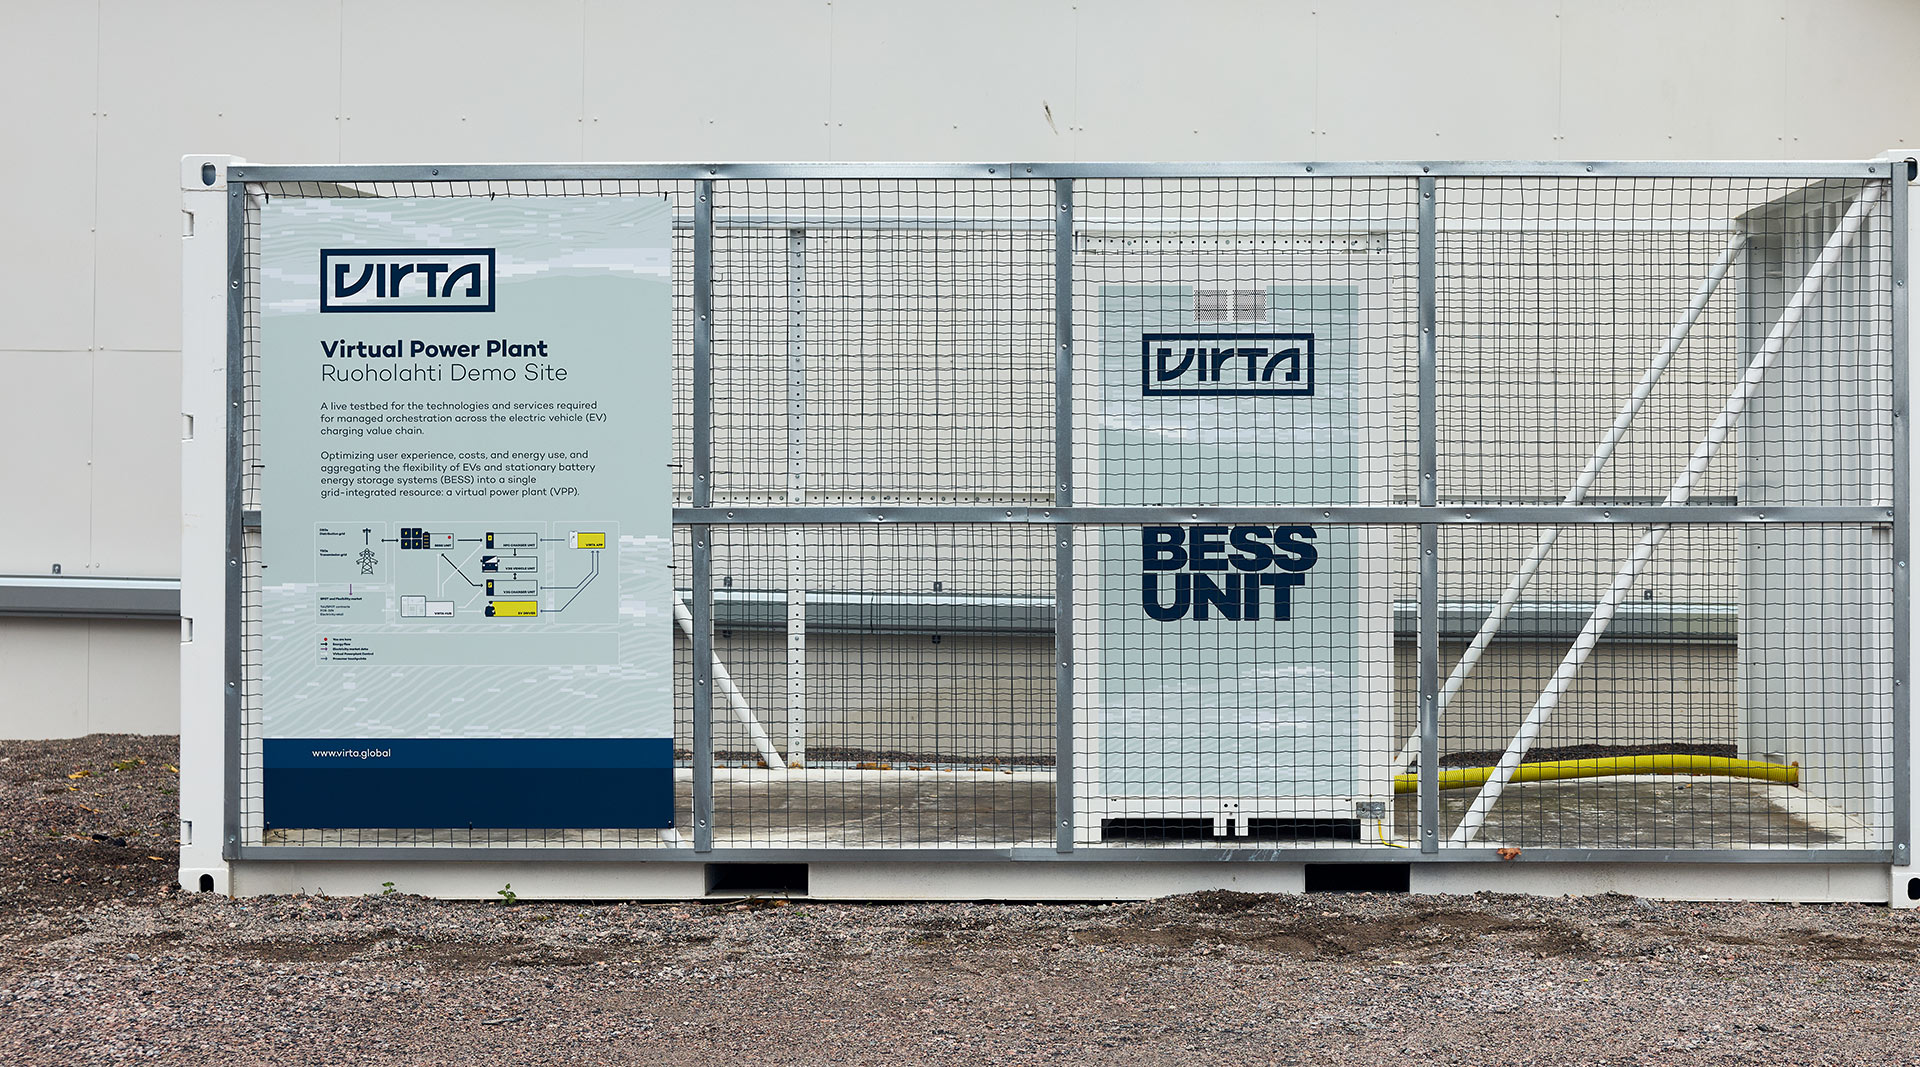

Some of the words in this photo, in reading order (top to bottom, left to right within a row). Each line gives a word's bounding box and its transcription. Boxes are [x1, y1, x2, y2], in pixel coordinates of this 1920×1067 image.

[335, 263, 481, 298] VIRTA
[320, 339, 402, 358] Virtual
[411, 340, 480, 358] Power
[487, 339, 548, 357] Plant
[1158, 348, 1300, 382] VIRTA
[322, 363, 441, 382] Ruoholahti
[451, 364, 516, 381] Demo
[525, 363, 567, 381] Site
[320, 402, 328, 410] A
[331, 402, 347, 411] live
[350, 401, 388, 411] testbed
[391, 401, 405, 410] for
[407, 401, 424, 410] the
[426, 401, 489, 413] technologies
[492, 401, 510, 410] and
[514, 401, 554, 411] services
[557, 401, 597, 411] required
[320, 414, 334, 423] for
[337, 414, 383, 425] managed
[386, 414, 452, 423] orchestration
[490, 414, 506, 422] the
[509, 413, 546, 422] electric
[549, 413, 583, 422] vehicle
[586, 413, 607, 422] (EV)
[320, 426, 363, 437] charging
[366, 428, 392, 436] value
[395, 426, 424, 435] chain.
[321, 451, 374, 462] Optimizing
[401, 450, 456, 461] experience,
[459, 451, 488, 460] costs,
[490, 450, 509, 459] and
[512, 452, 545, 462] energy
[548, 452, 567, 460] use,
[570, 450, 588, 459] and
[321, 463, 381, 474] aggregating
[383, 463, 400, 472] the
[402, 463, 447, 473] flexibility
[450, 463, 460, 471] of
[463, 463, 481, 471] EVs
[484, 463, 502, 471] and
[505, 463, 556, 473] stationary
[559, 463, 595, 473] battery
[321, 478, 354, 487] energy
[357, 476, 394, 486] storage
[397, 476, 438, 486] systems
[440, 475, 474, 485] (BESS)
[477, 475, 496, 484] into
[508, 475, 536, 486] single
[321, 488, 396, 499] grid-integrated
[455, 488, 486, 496] virtual
[490, 490, 519, 498] power
[522, 488, 547, 498] plant
[550, 487, 579, 496] (VPP).
[1143, 526, 1318, 571] BESS
[1143, 573, 1305, 622] UNIT
[312, 749, 391, 759] www.virta.global
